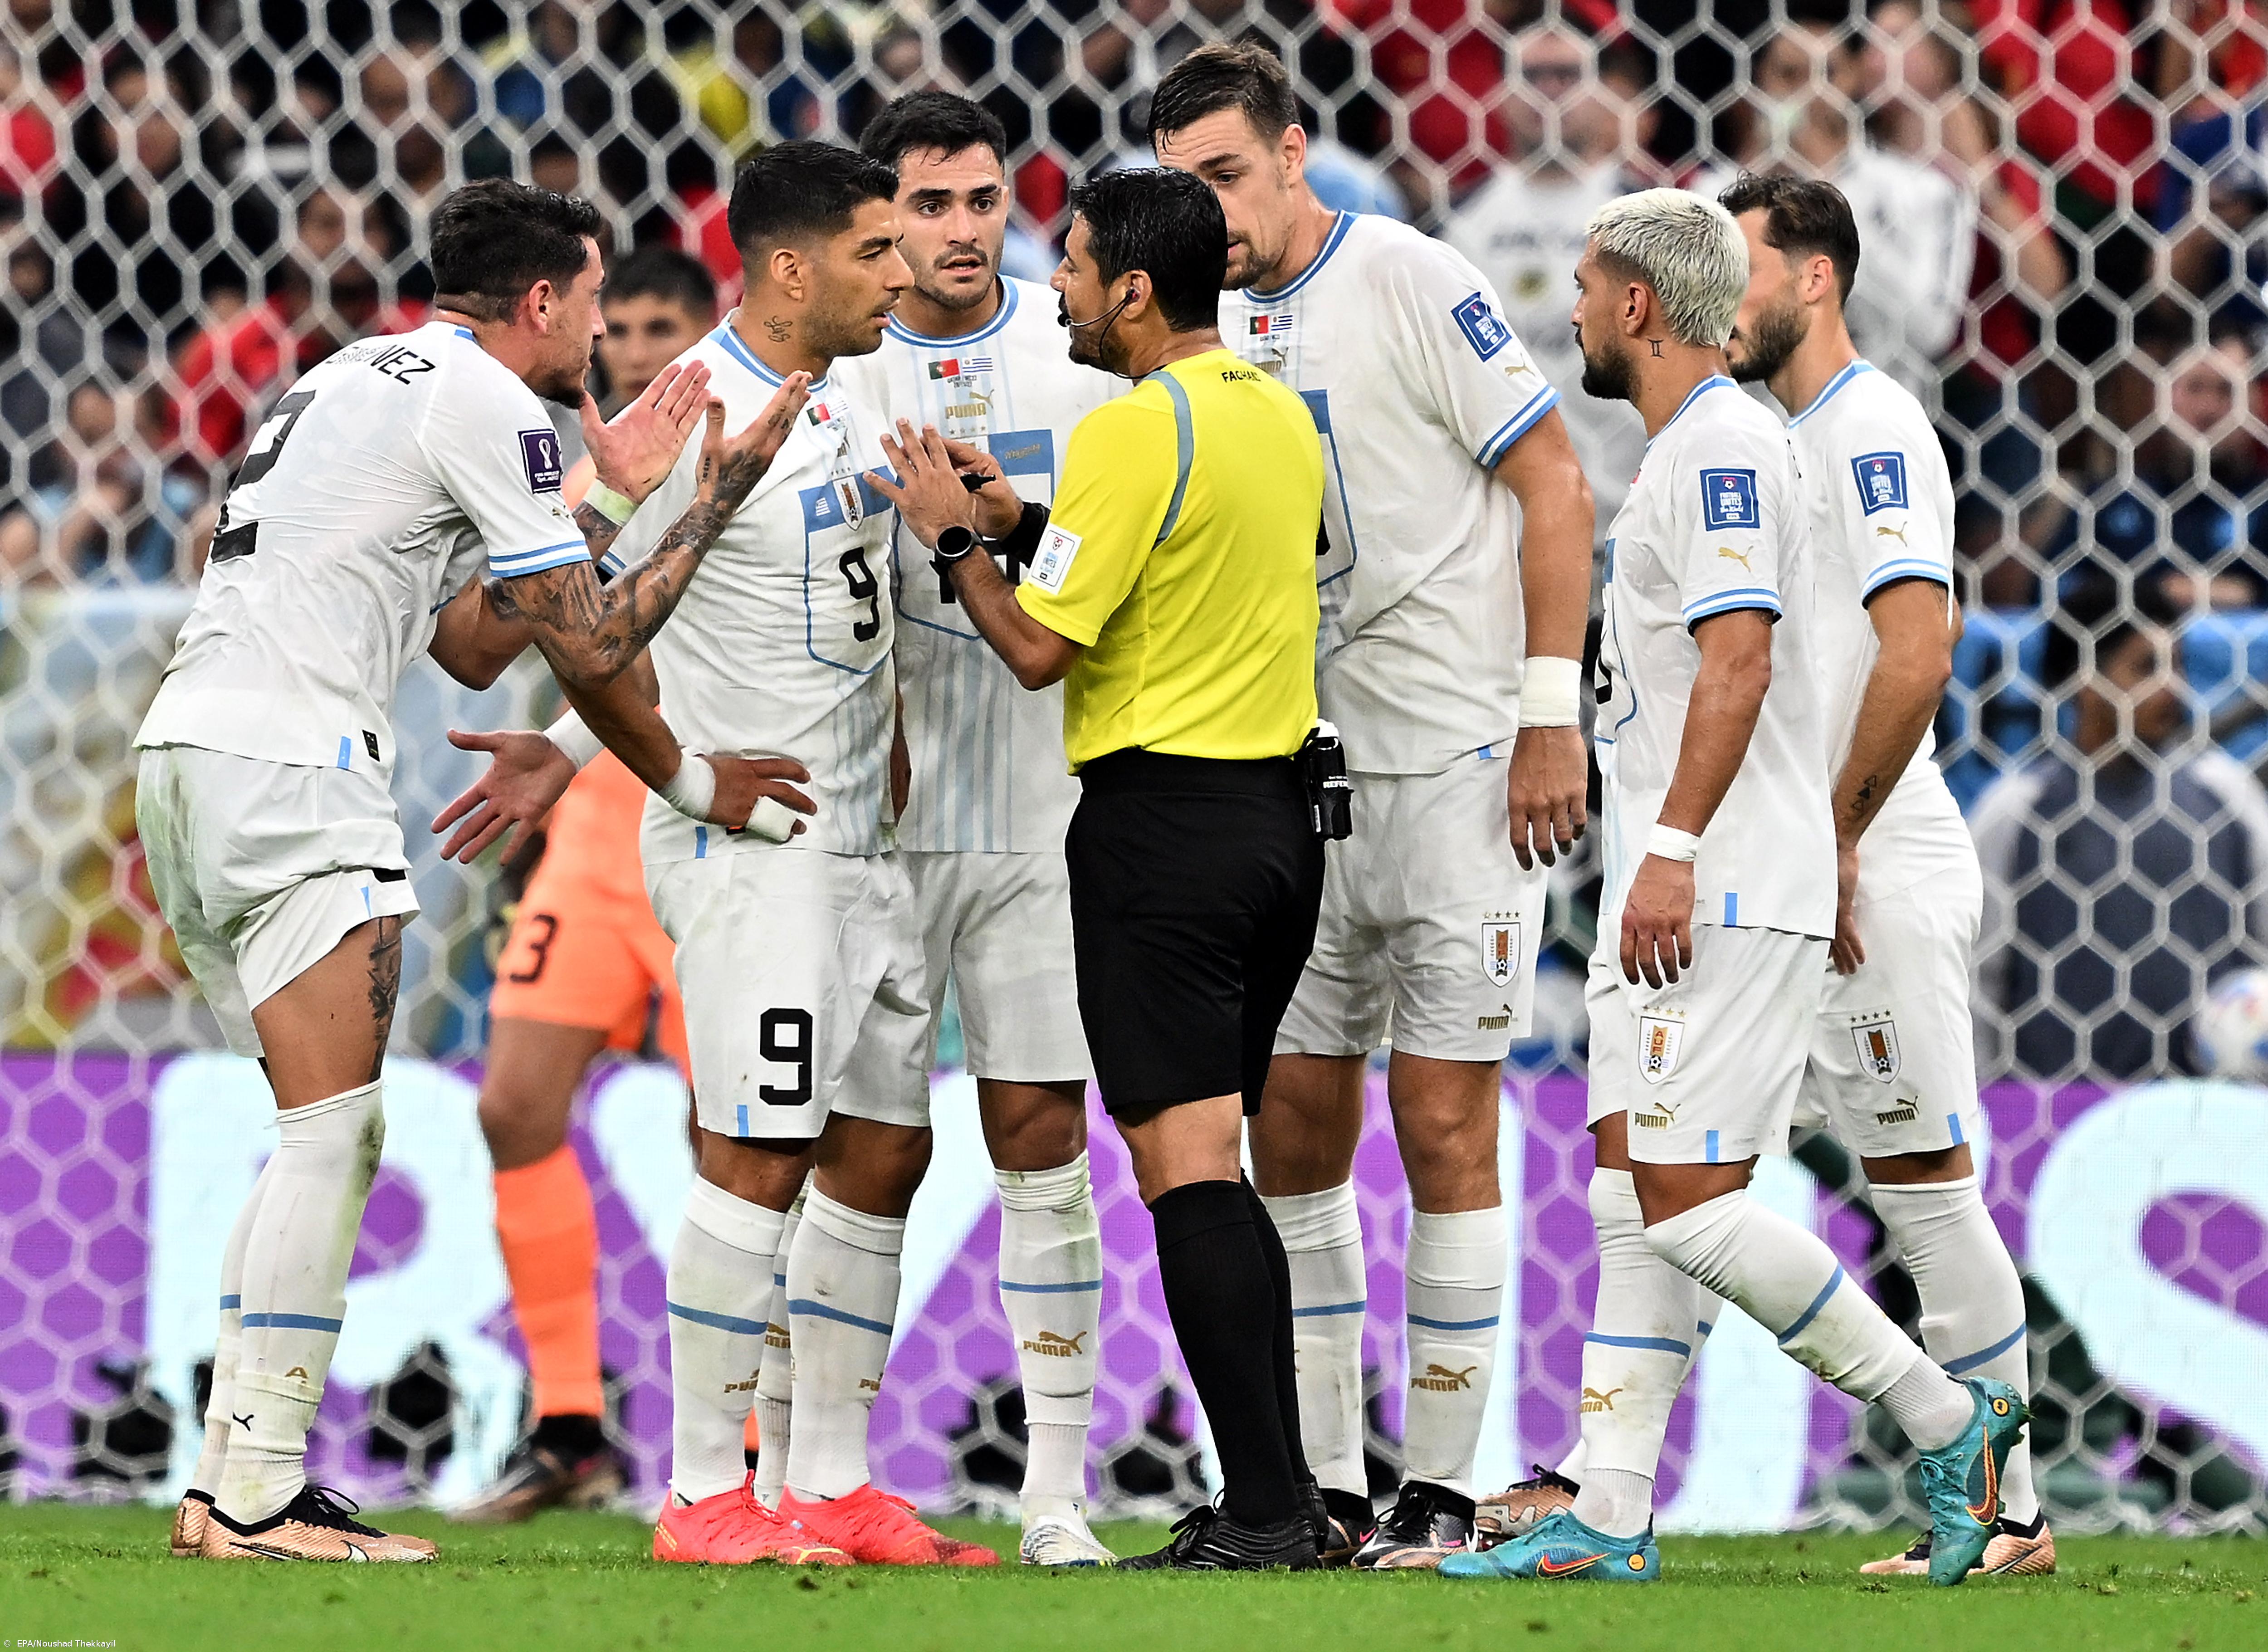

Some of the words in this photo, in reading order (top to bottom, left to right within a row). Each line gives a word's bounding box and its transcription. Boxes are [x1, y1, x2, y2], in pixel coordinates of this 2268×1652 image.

[945, 403, 986, 419] PUMA
[211, 390, 316, 564] 2
[839, 547, 880, 642] 9
[1477, 1016, 1510, 1030] PUMA
[760, 1008, 813, 1106] 9
[1634, 1112, 1668, 1130] PUMA
[1877, 1108, 1916, 1125] PUMA
[1023, 1340, 1072, 1357] PUMA
[1411, 1378, 1459, 1391] PUMA
